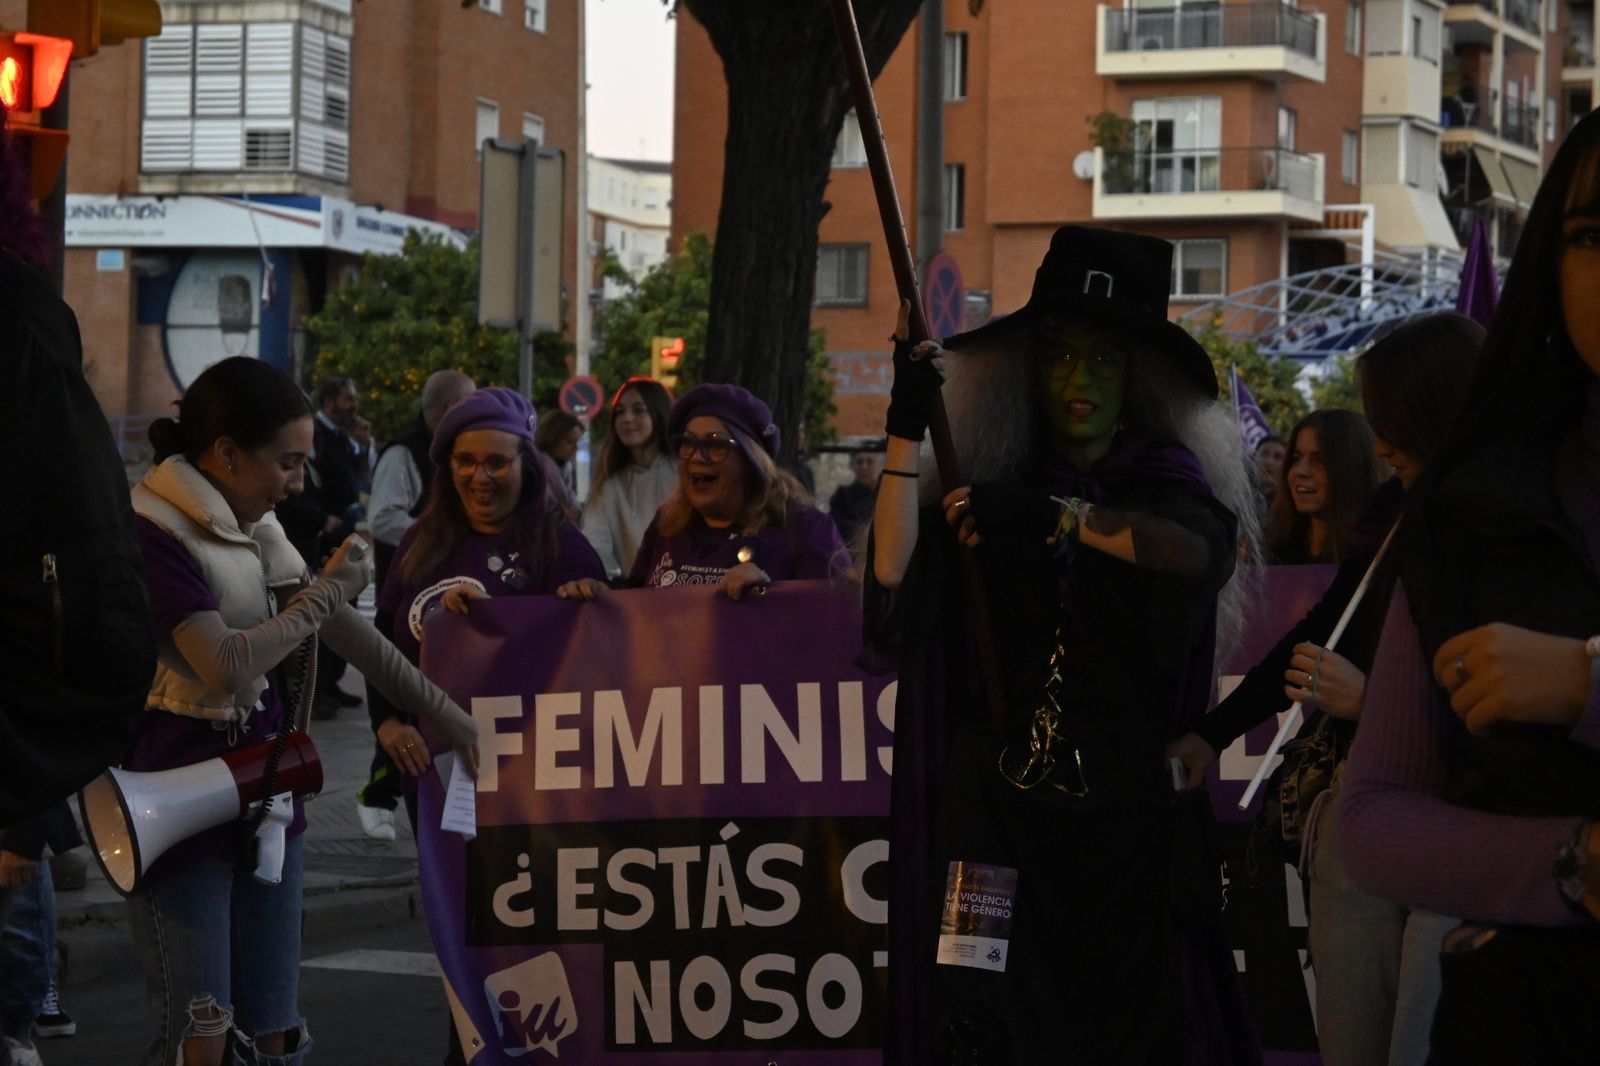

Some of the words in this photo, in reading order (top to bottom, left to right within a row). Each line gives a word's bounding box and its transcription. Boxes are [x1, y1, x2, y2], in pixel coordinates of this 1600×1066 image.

[960, 892, 1011, 908] VIOLENCIA
[946, 902, 968, 912] TIENE
[971, 904, 1011, 919] GÉNERO
